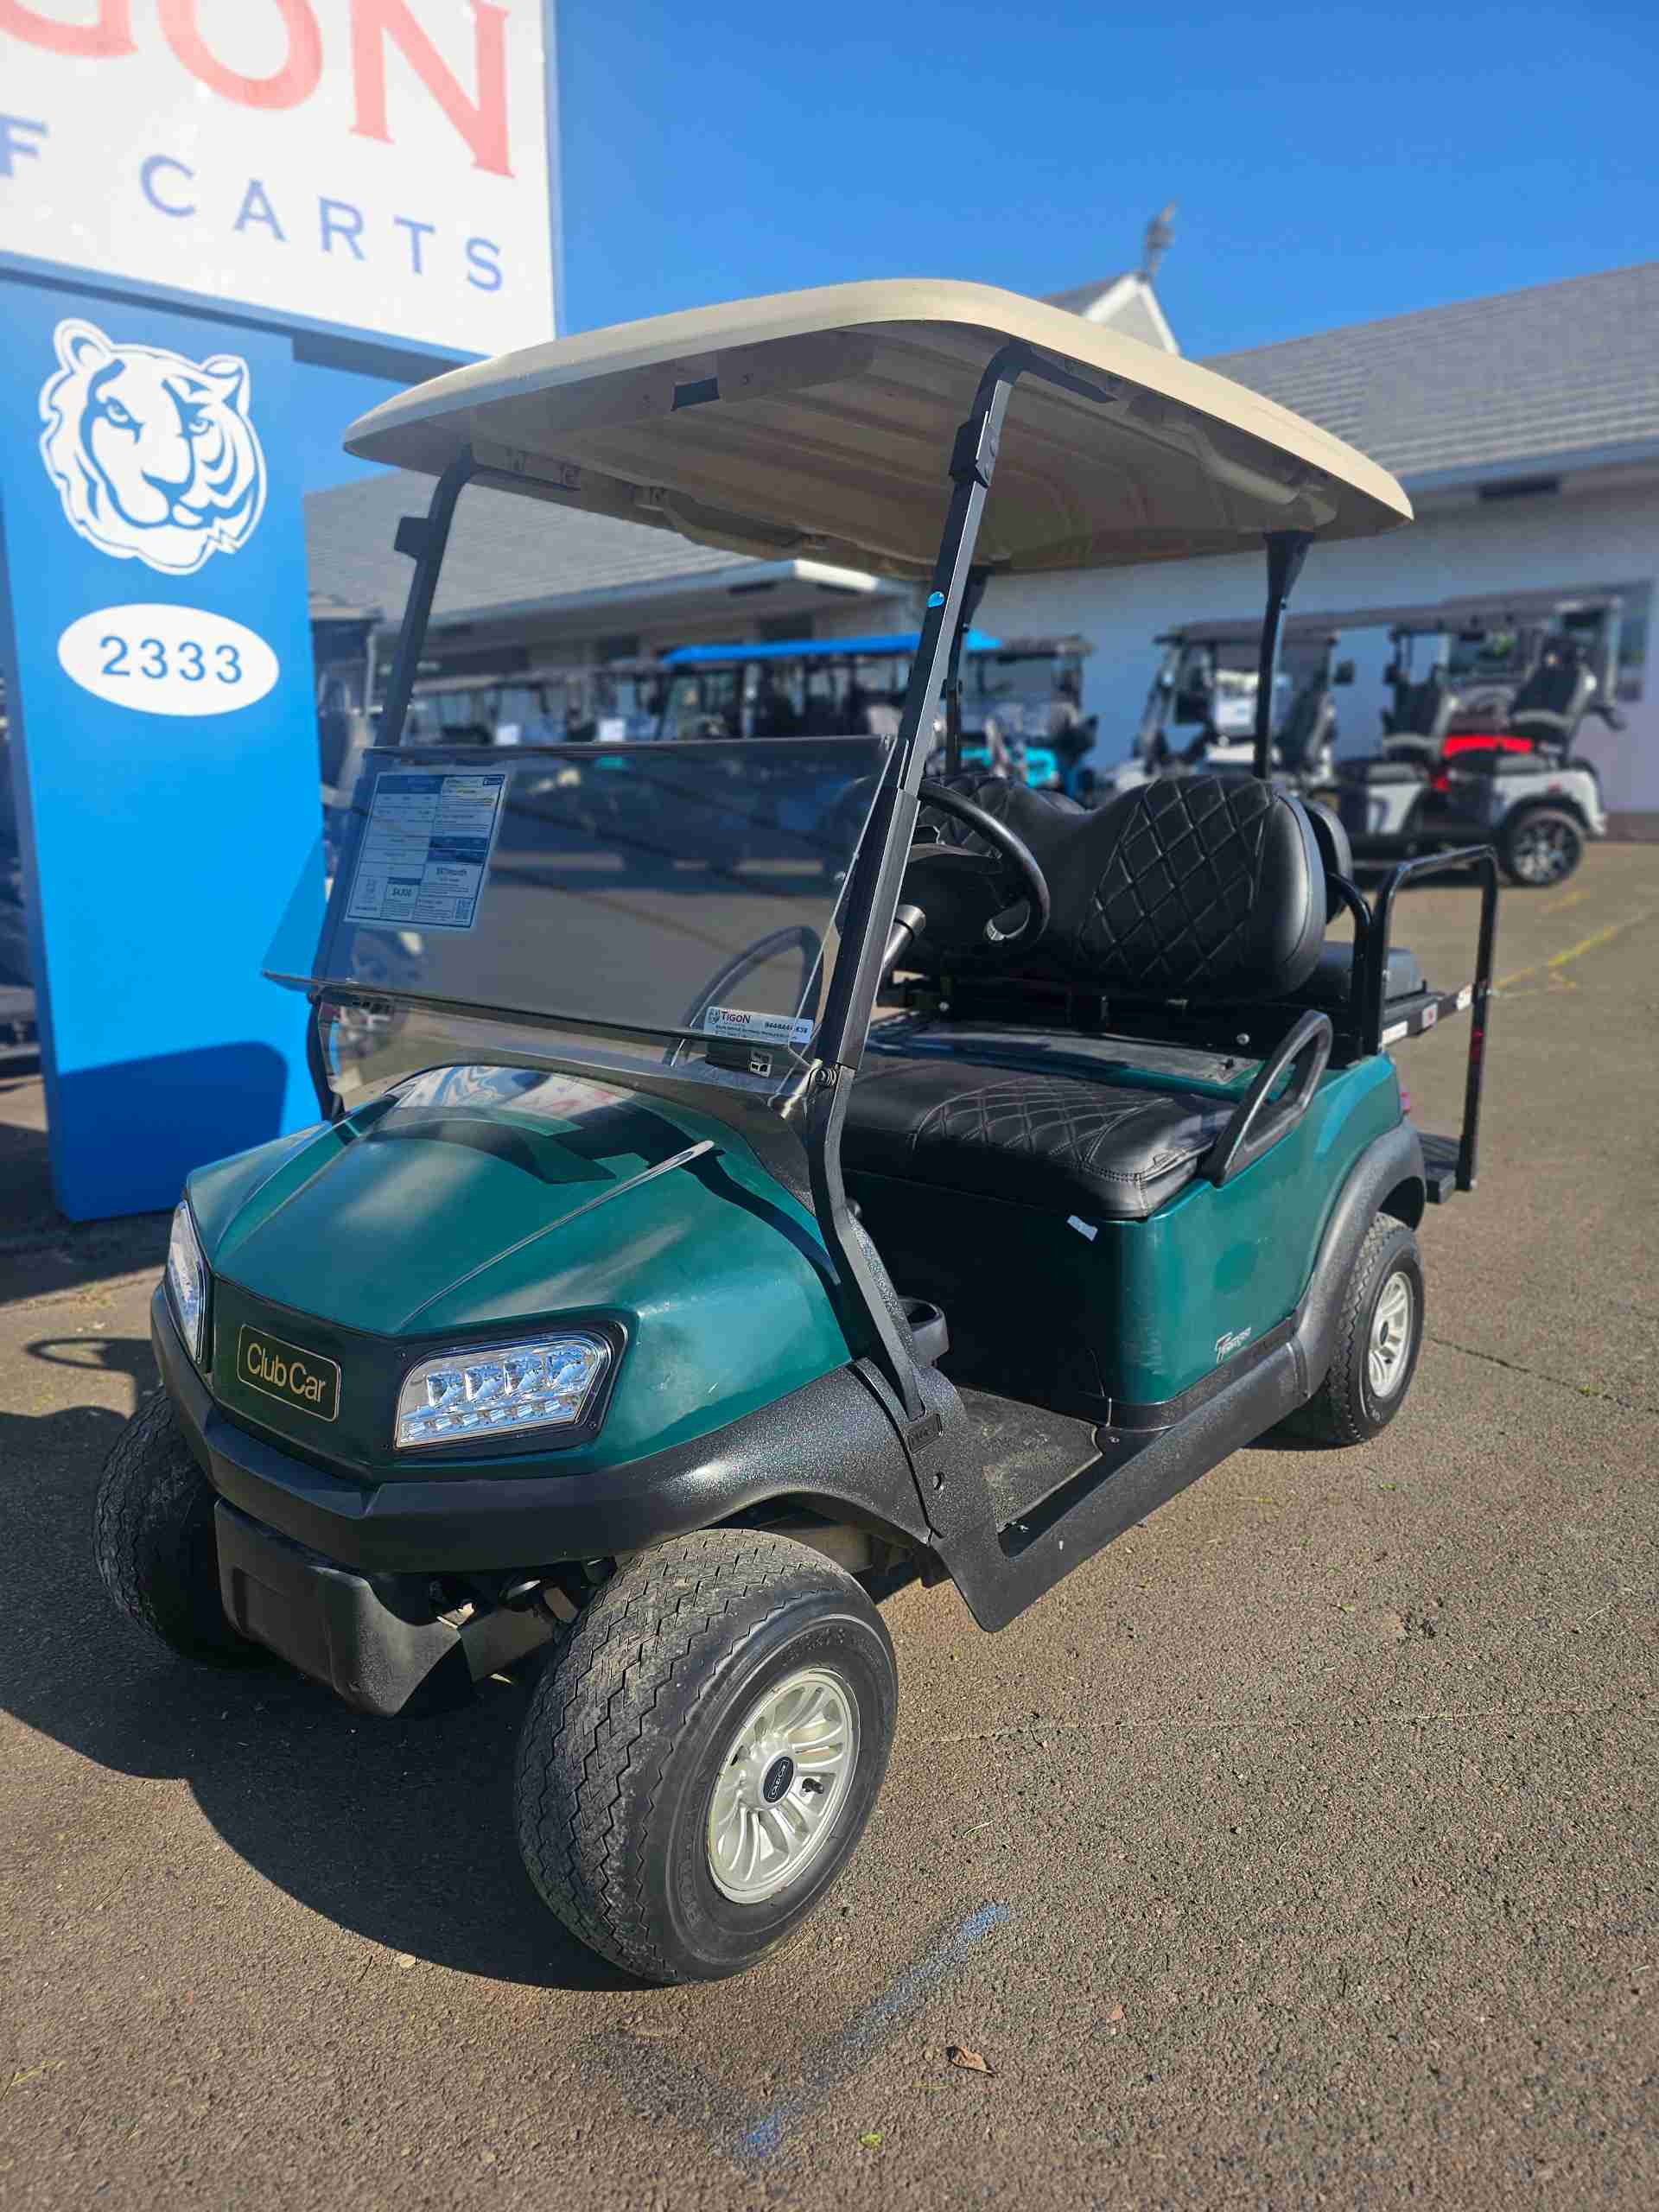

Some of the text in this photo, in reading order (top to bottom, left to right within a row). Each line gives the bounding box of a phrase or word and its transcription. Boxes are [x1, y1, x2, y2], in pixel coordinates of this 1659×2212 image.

[0, 0, 516, 180] ON
[138, 153, 505, 293] CARTS
[99, 634, 244, 684] 2333
[721, 1010, 751, 1024] TIGON
[246, 1342, 327, 1403] Club Car
